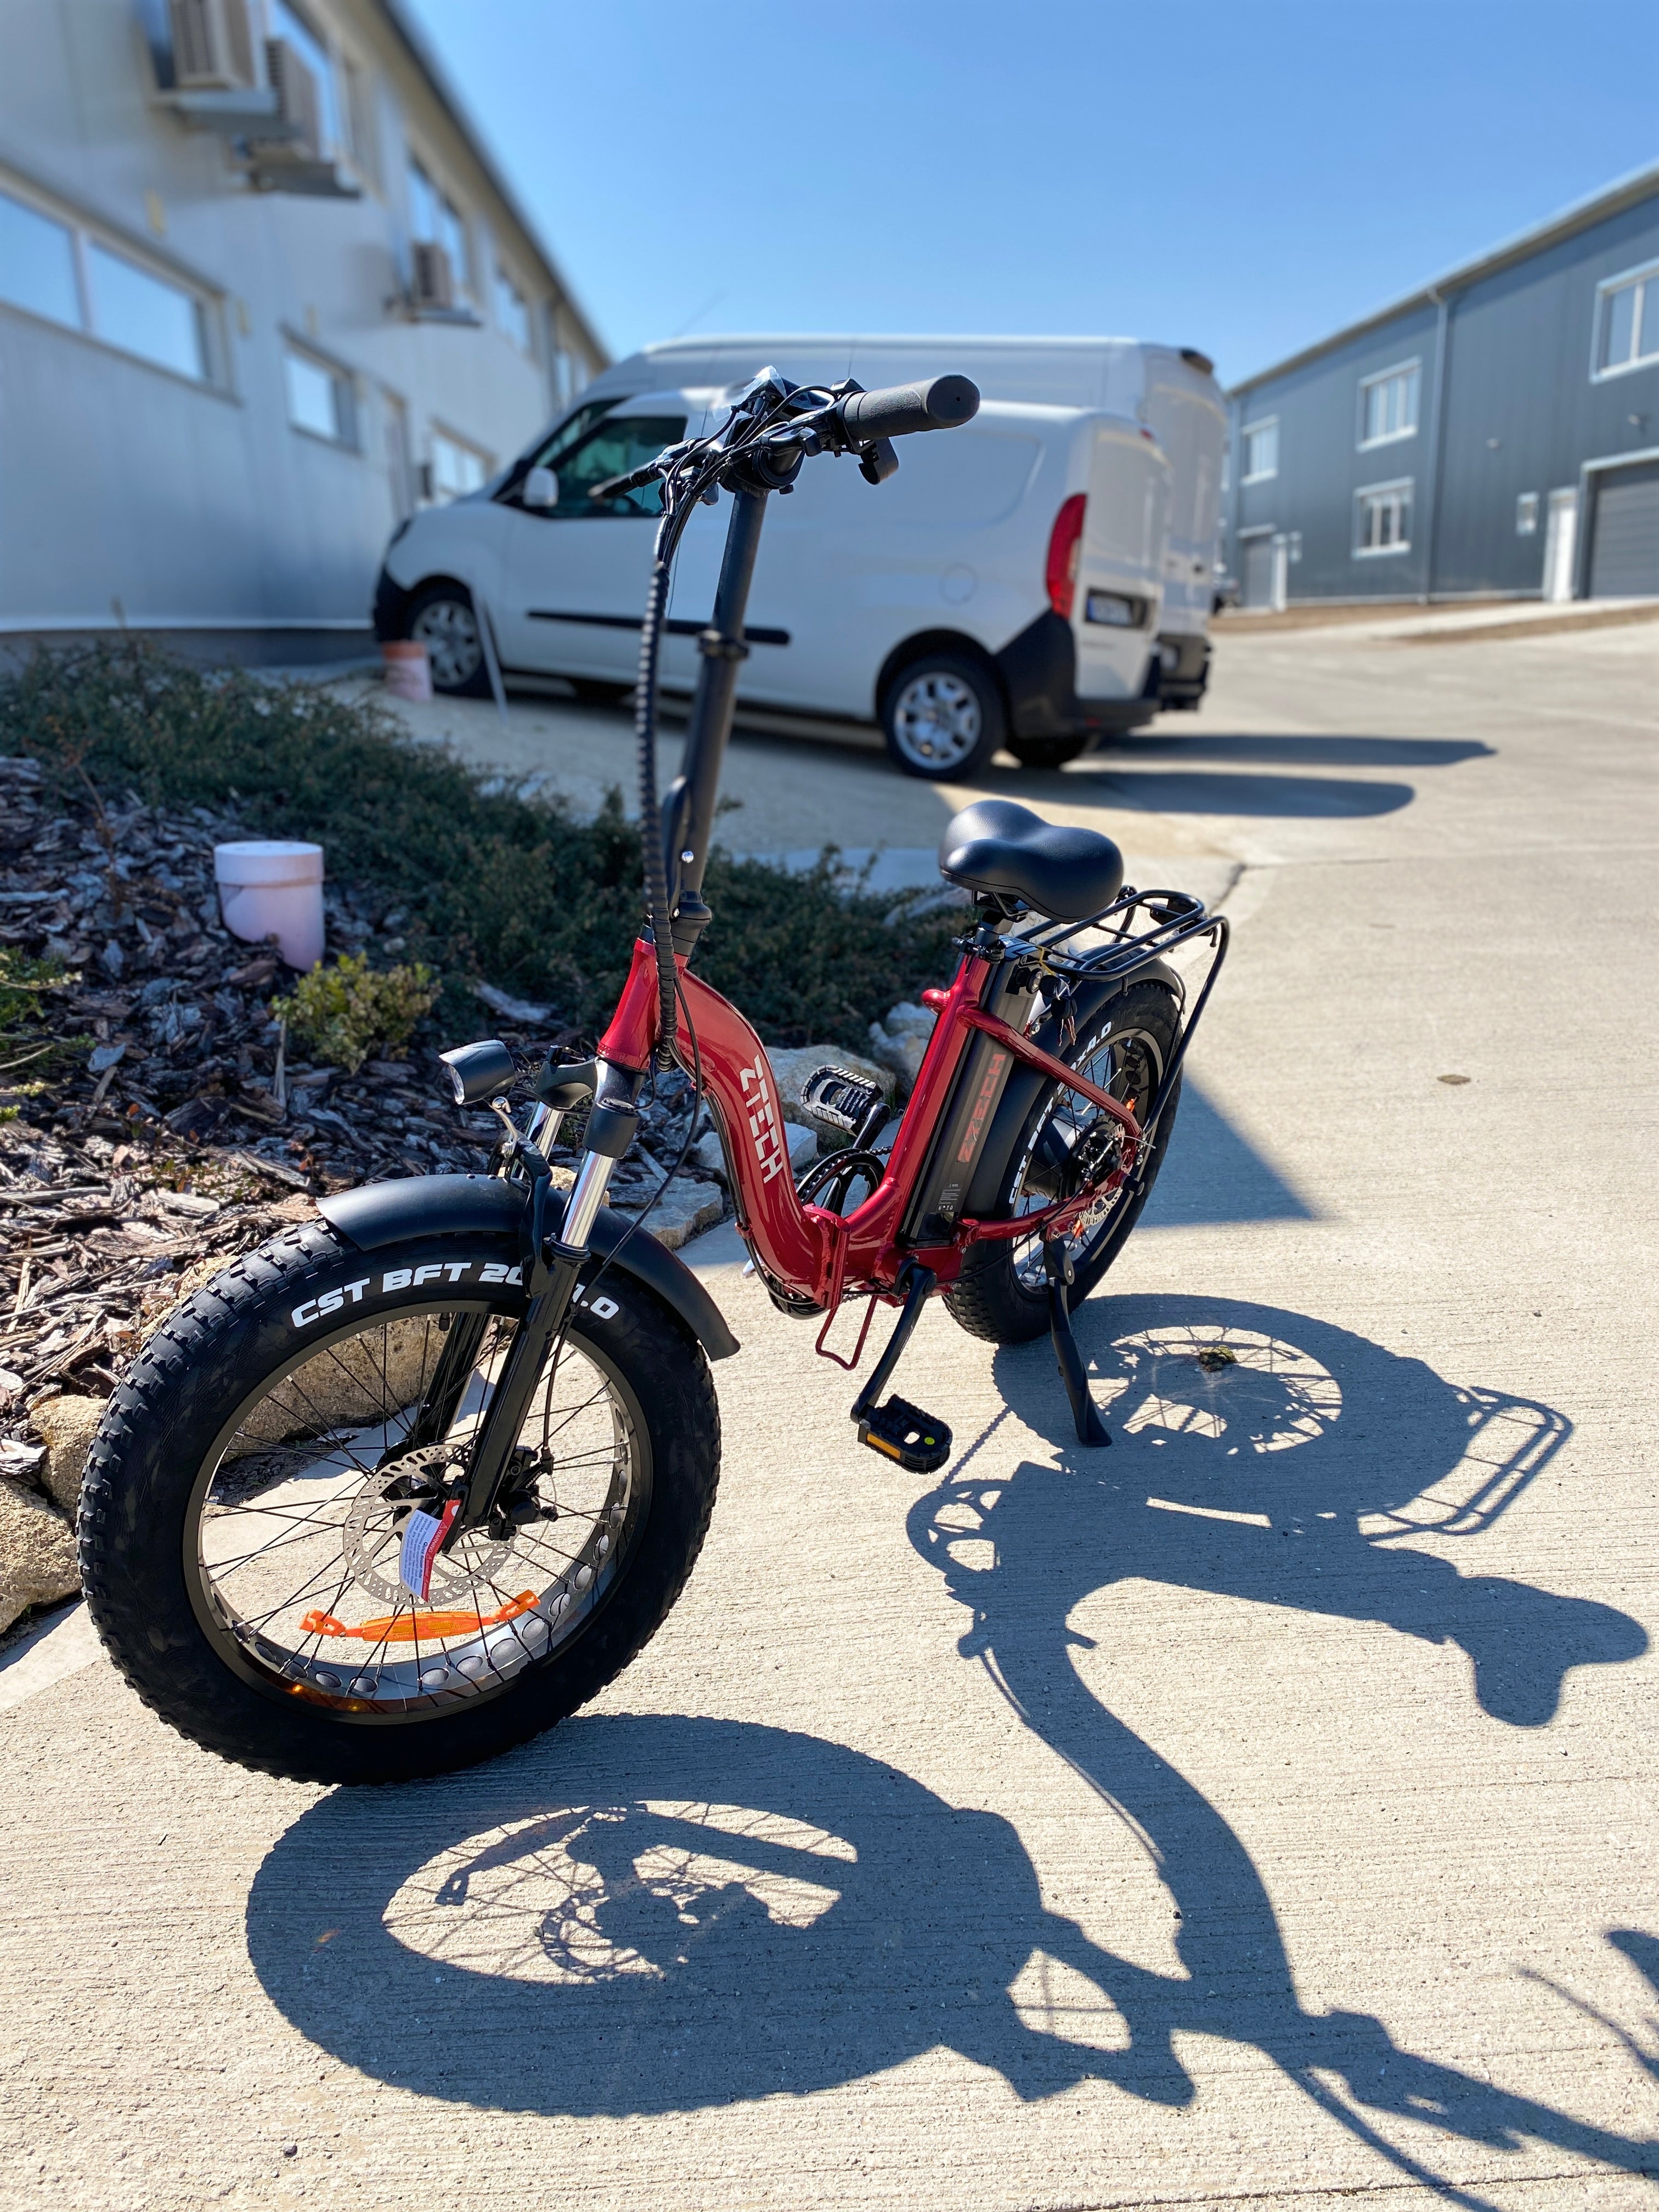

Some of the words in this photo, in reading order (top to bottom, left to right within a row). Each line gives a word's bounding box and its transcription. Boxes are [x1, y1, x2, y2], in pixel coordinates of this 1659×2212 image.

[740, 1054, 783, 1183] ZTECH
[957, 1053, 1006, 1163] ZTECH
[1009, 1155, 1027, 1204] CST
[1028, 1097, 1053, 1150] BFT
[291, 1278, 370, 1328] CST
[382, 1262, 472, 1293] BFT
[429, 1529, 443, 1553] WARNING
